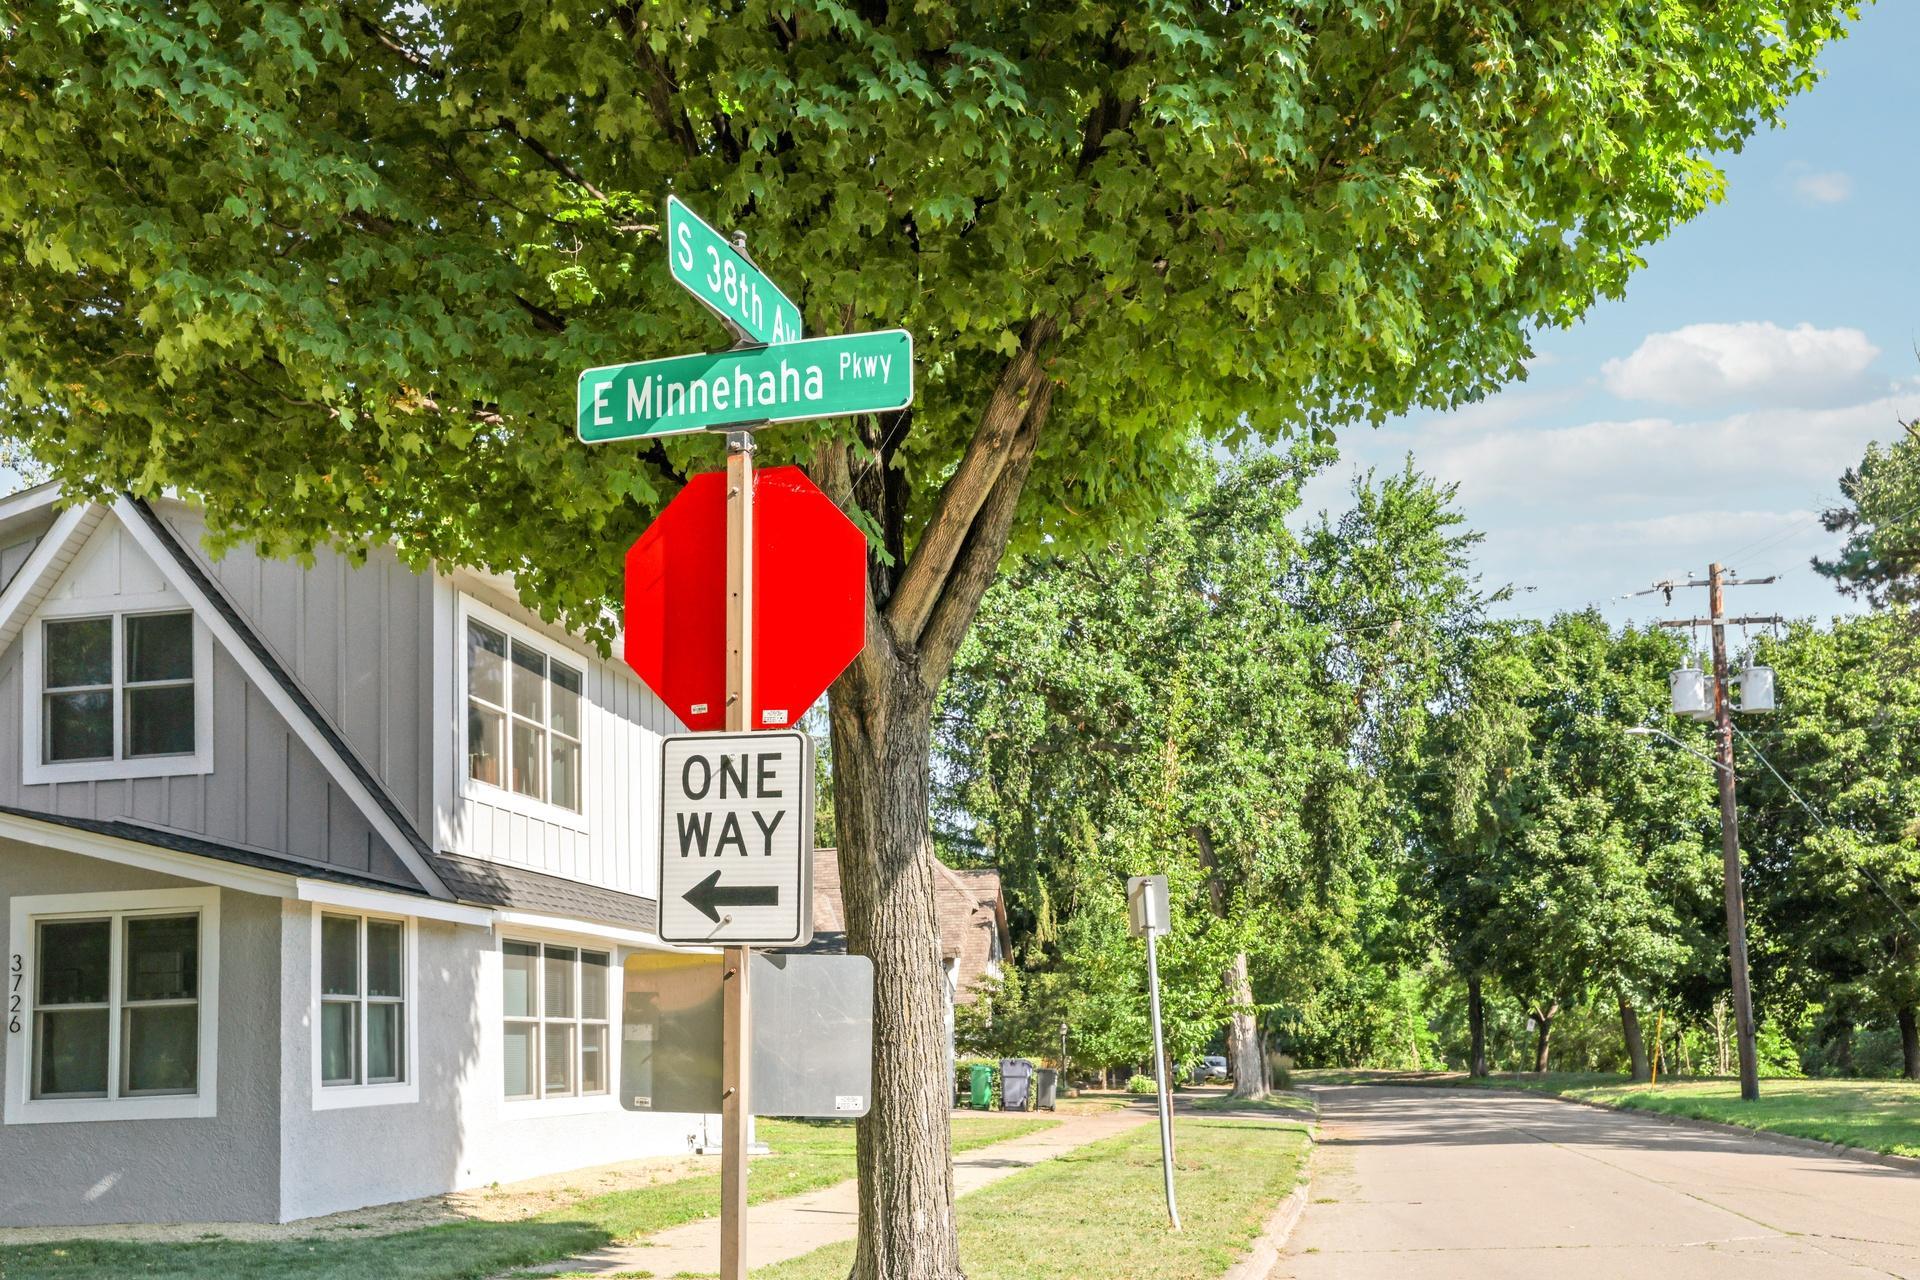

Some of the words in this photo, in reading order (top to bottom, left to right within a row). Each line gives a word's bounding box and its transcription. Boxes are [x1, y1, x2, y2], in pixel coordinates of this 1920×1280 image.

[677, 222, 693, 272] S
[706, 246, 763, 331] 38th
[593, 382, 613, 426] E
[627, 359, 823, 421] Minnehaha
[840, 352, 892, 384] Pkwy
[682, 753, 782, 800] ONE
[677, 810, 786, 857] WAY
[10, 954, 22, 1033] 3726
